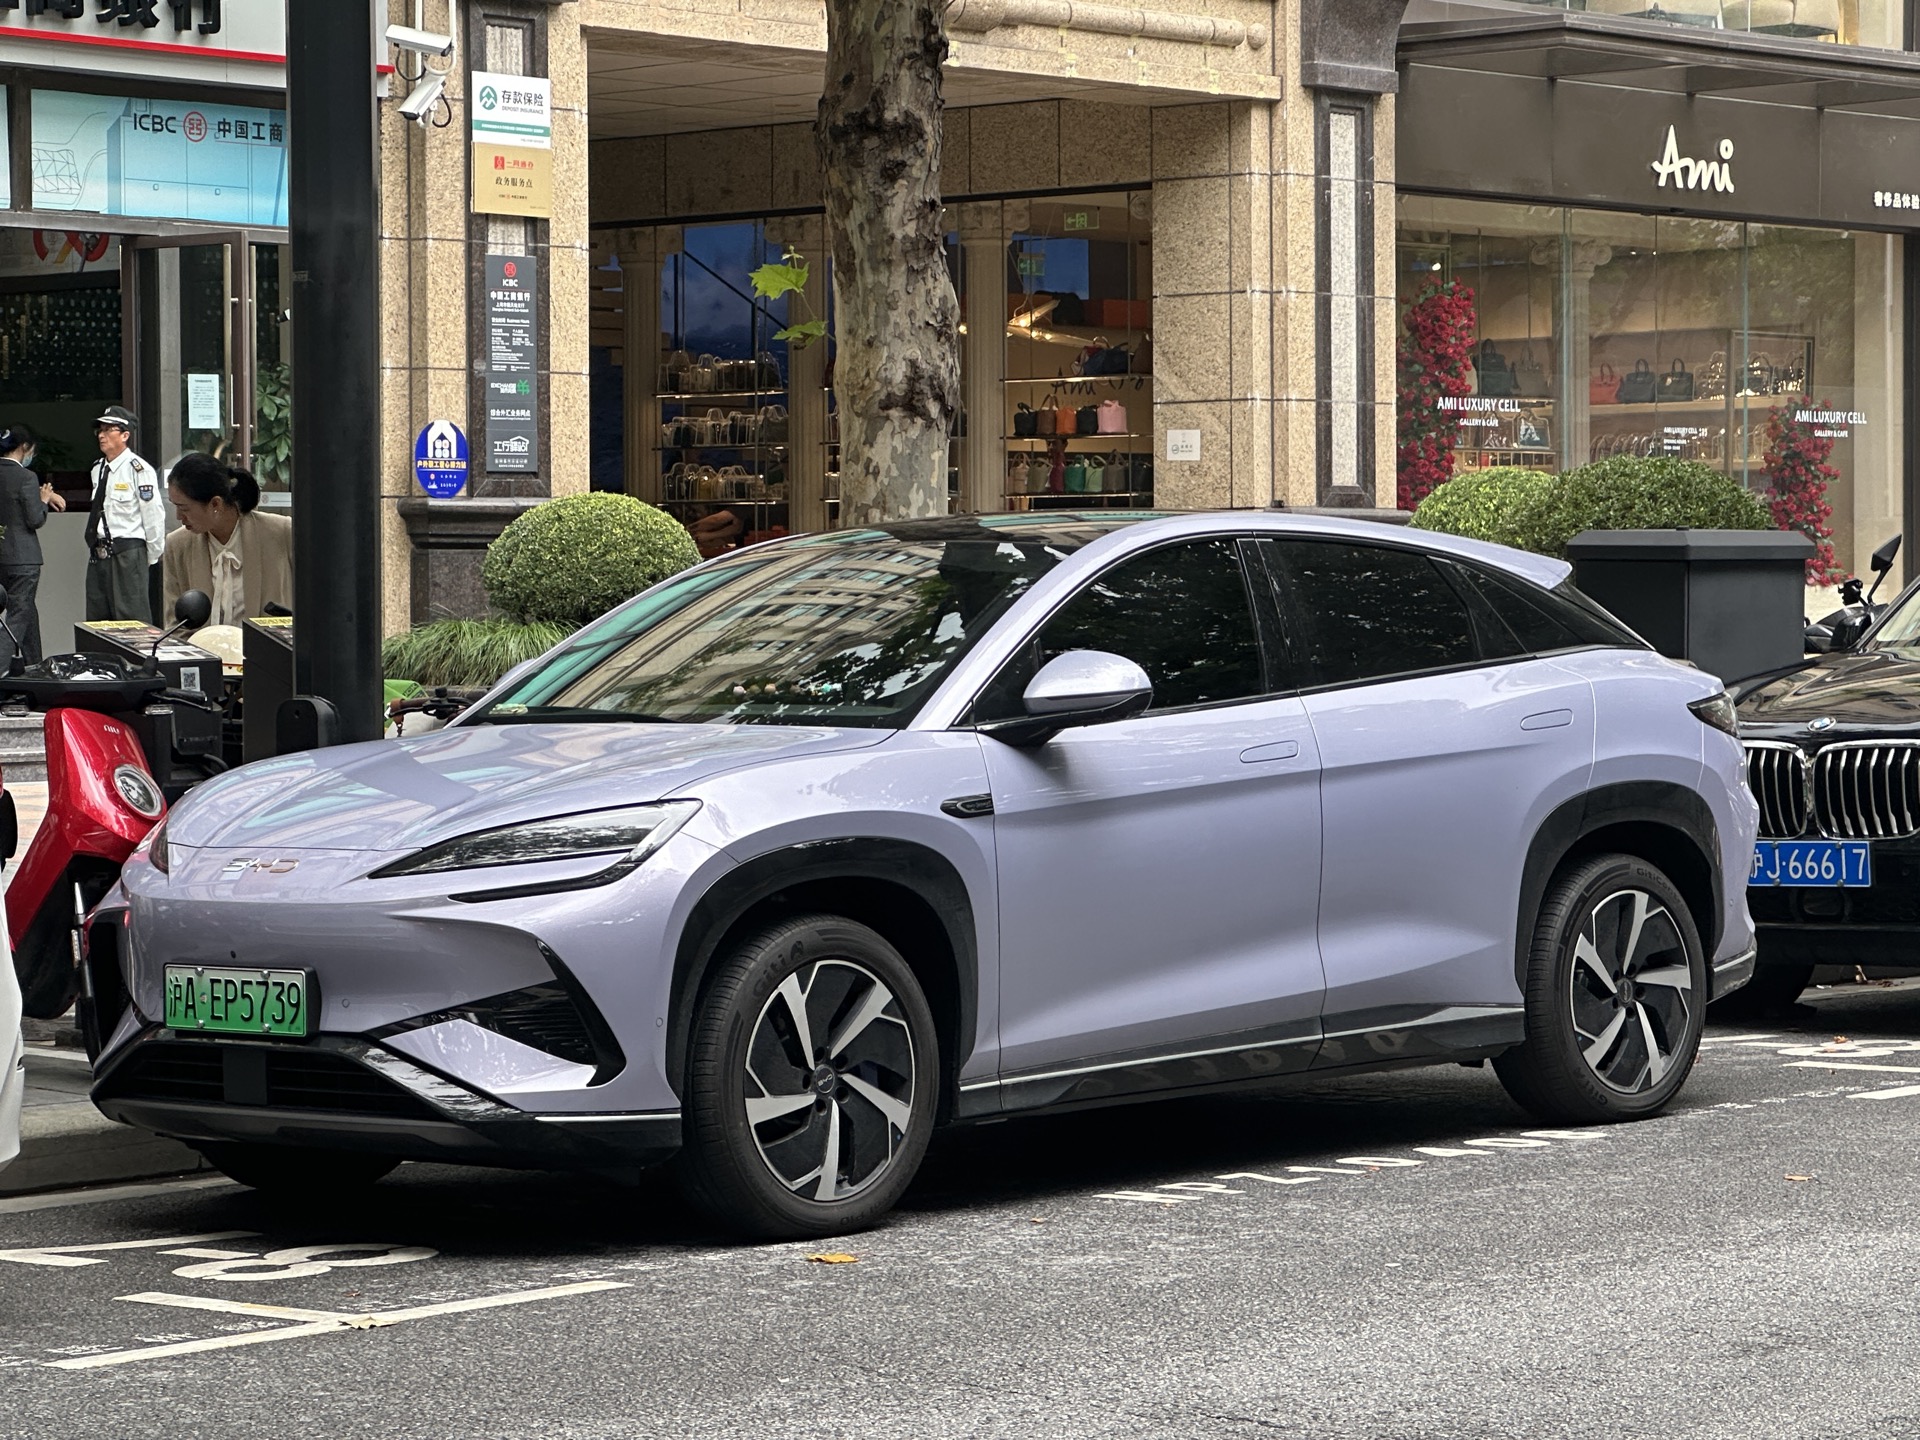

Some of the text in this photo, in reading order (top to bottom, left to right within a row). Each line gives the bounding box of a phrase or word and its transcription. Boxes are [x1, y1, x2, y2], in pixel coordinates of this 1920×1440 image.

[501, 90, 544, 107] 存款保险
[133, 113, 283, 142] ICBC 中国工商
[1651, 124, 1735, 193] Ami
[495, 176, 533, 188] 政务服务点
[502, 278, 519, 287] ICBC
[1437, 397, 1521, 413] AMI LUXURY CELL
[1795, 410, 1867, 425] AMI LUXURY CELL
[222, 857, 300, 874] BYD
